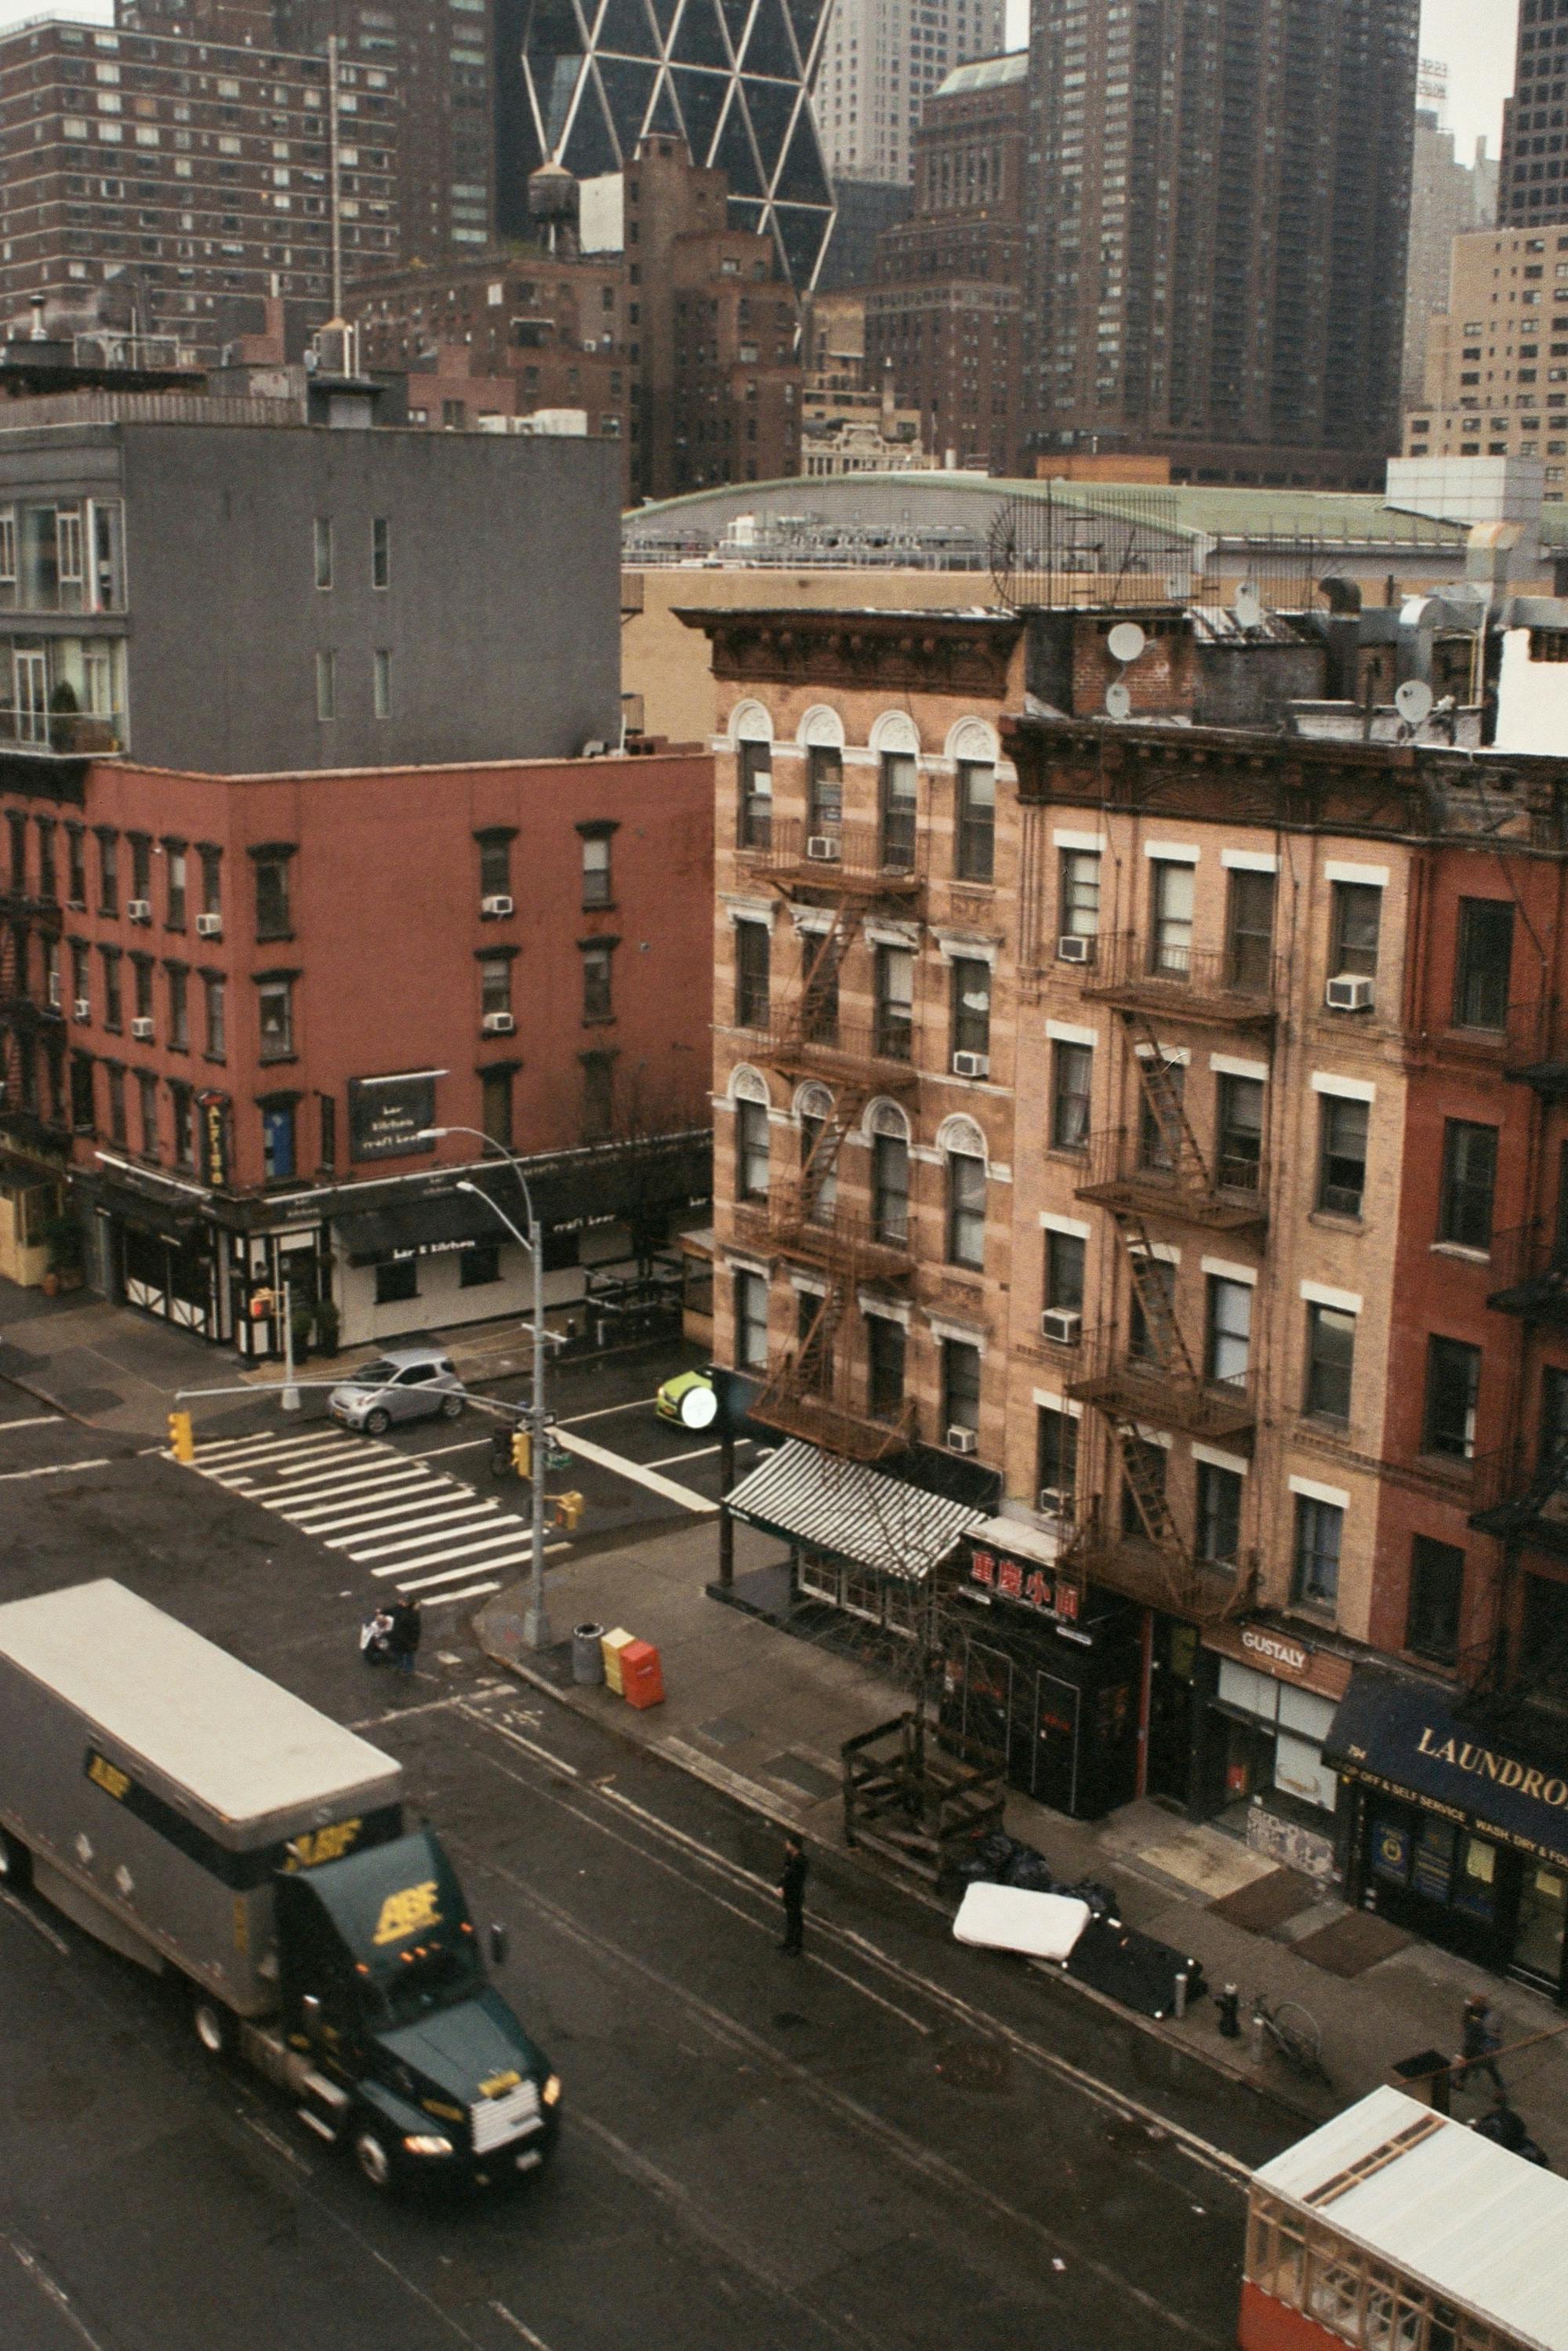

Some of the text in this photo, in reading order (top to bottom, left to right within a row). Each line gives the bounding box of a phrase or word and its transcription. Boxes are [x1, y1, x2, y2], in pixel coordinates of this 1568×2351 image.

[1242, 1631, 1307, 1669] GUSTALY
[1417, 1725, 1568, 1812] LAUNDRO
[1392, 1783, 1419, 1803] SELF
[1419, 1794, 1468, 1824] SERVICE
[1512, 1833, 1537, 1853] DRY
